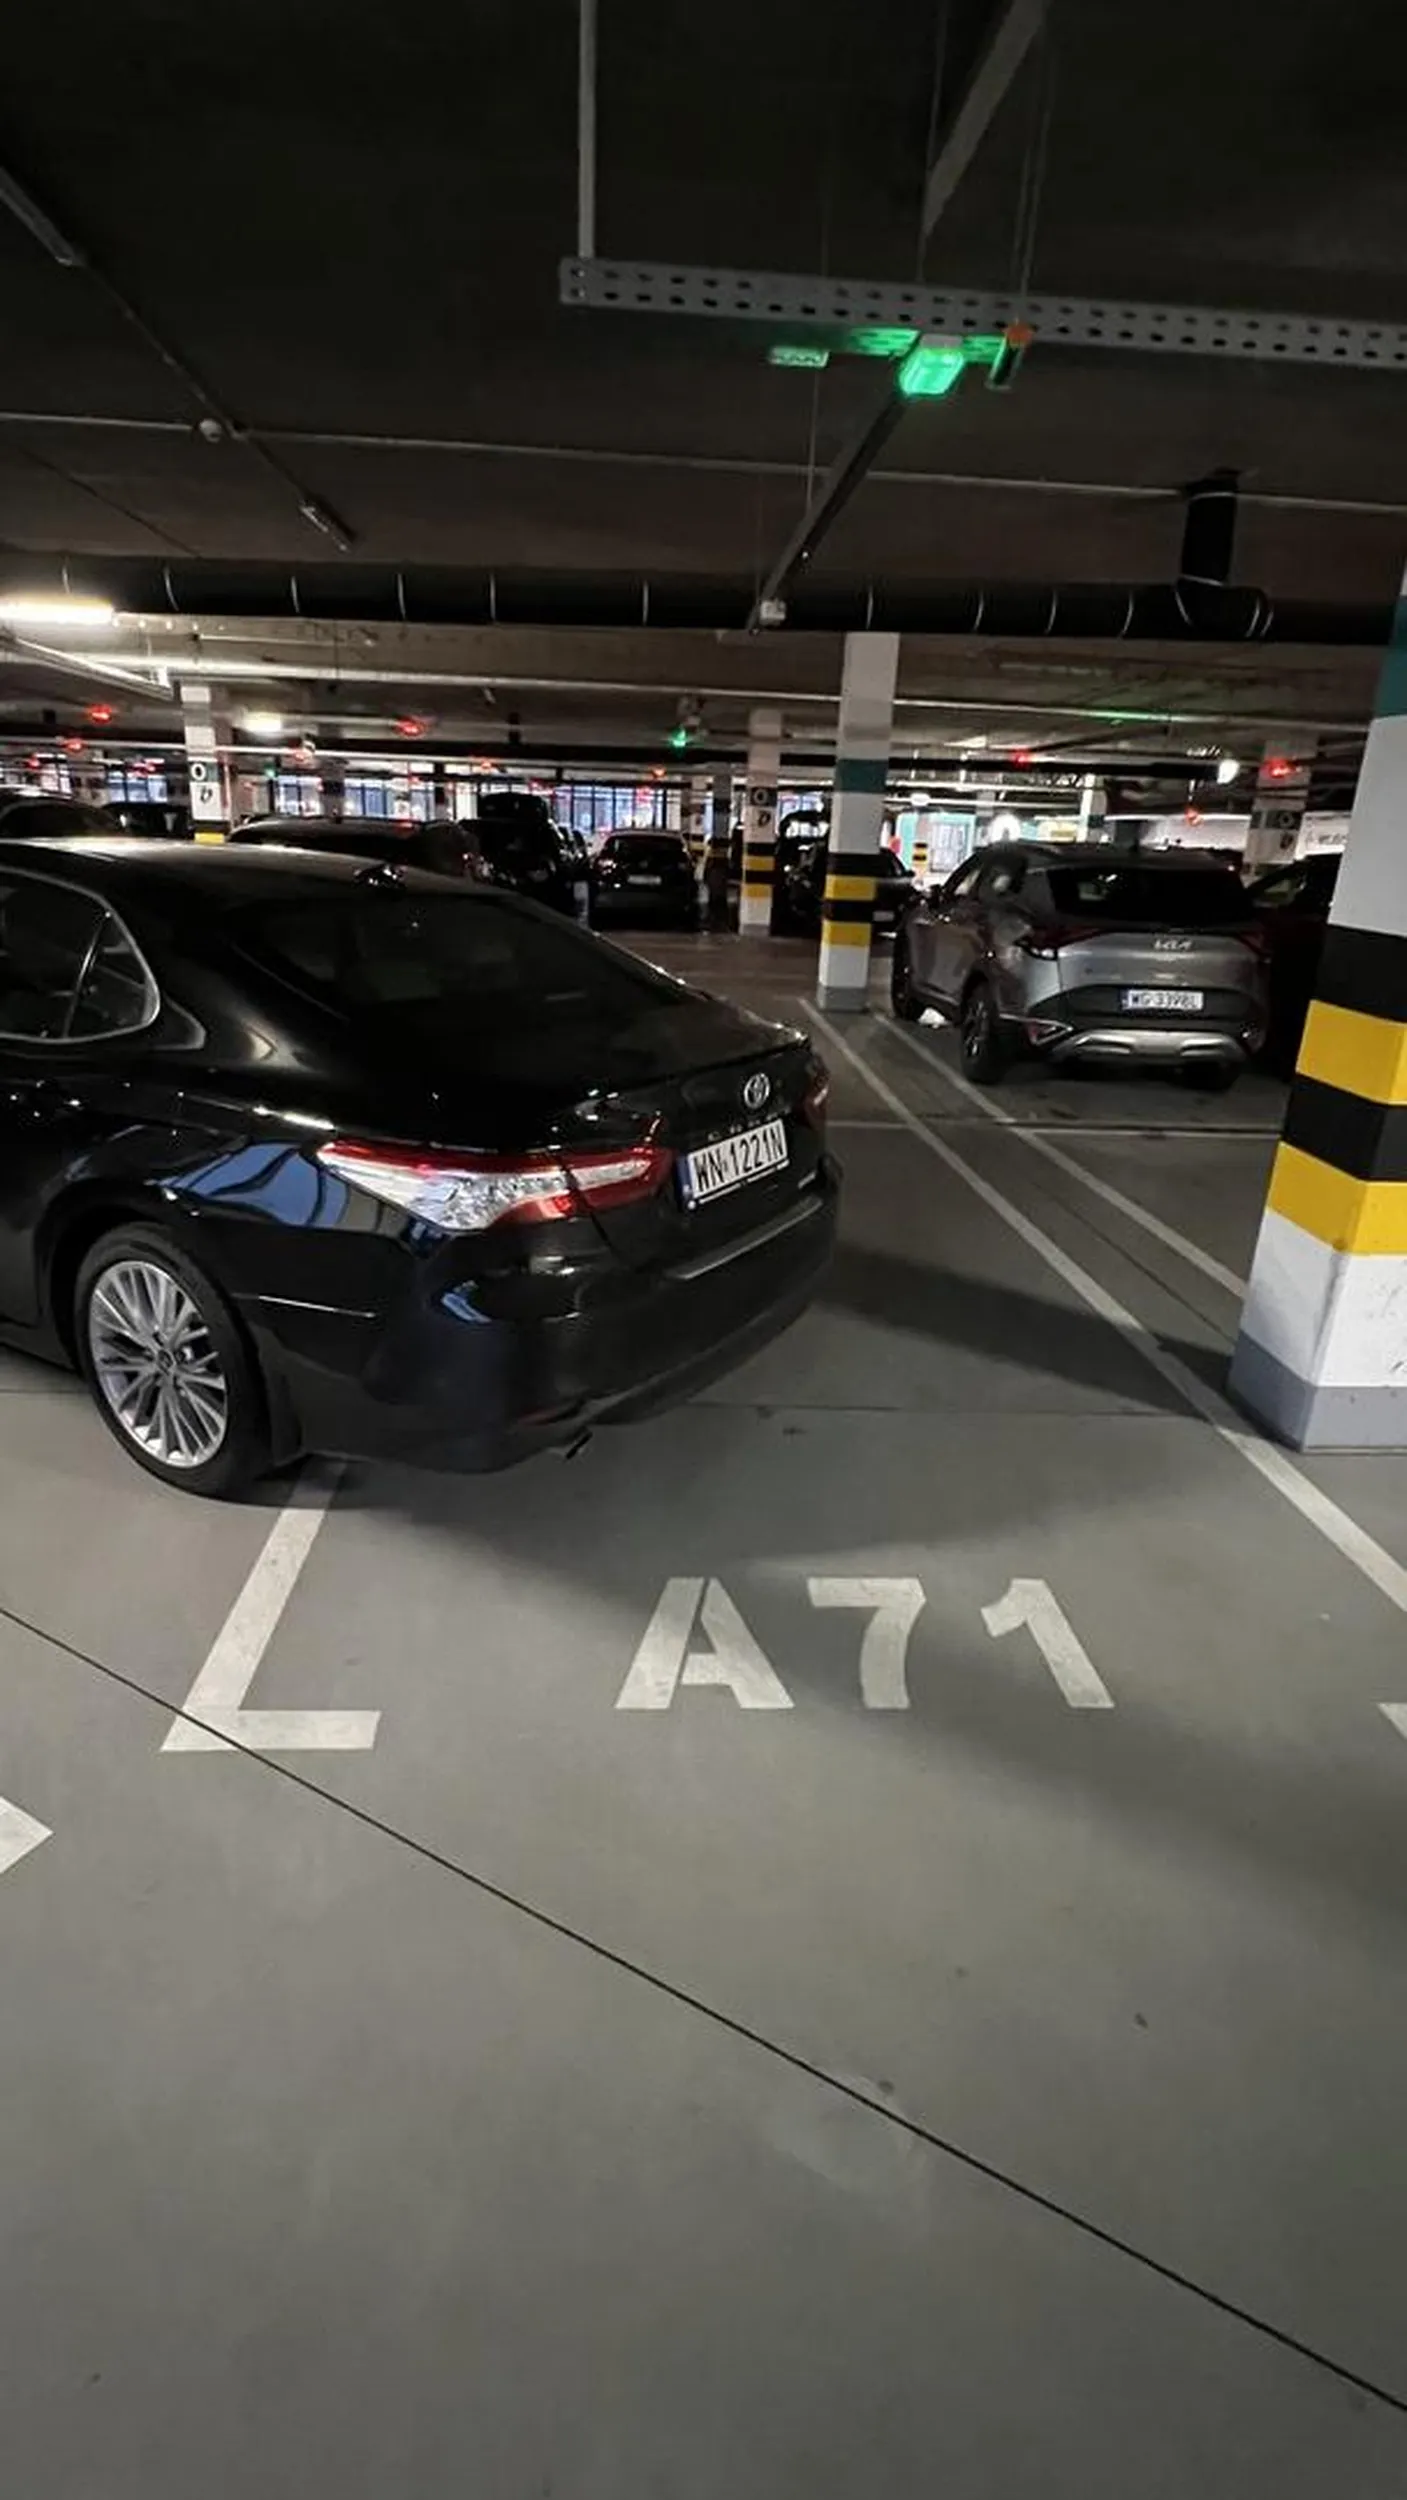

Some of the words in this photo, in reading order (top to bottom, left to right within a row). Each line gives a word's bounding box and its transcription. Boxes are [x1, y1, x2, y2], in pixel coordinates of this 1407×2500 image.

[693, 1147, 725, 1193] WN
[729, 1123, 785, 1176] 1221N
[613, 1576, 1116, 1709] A71
